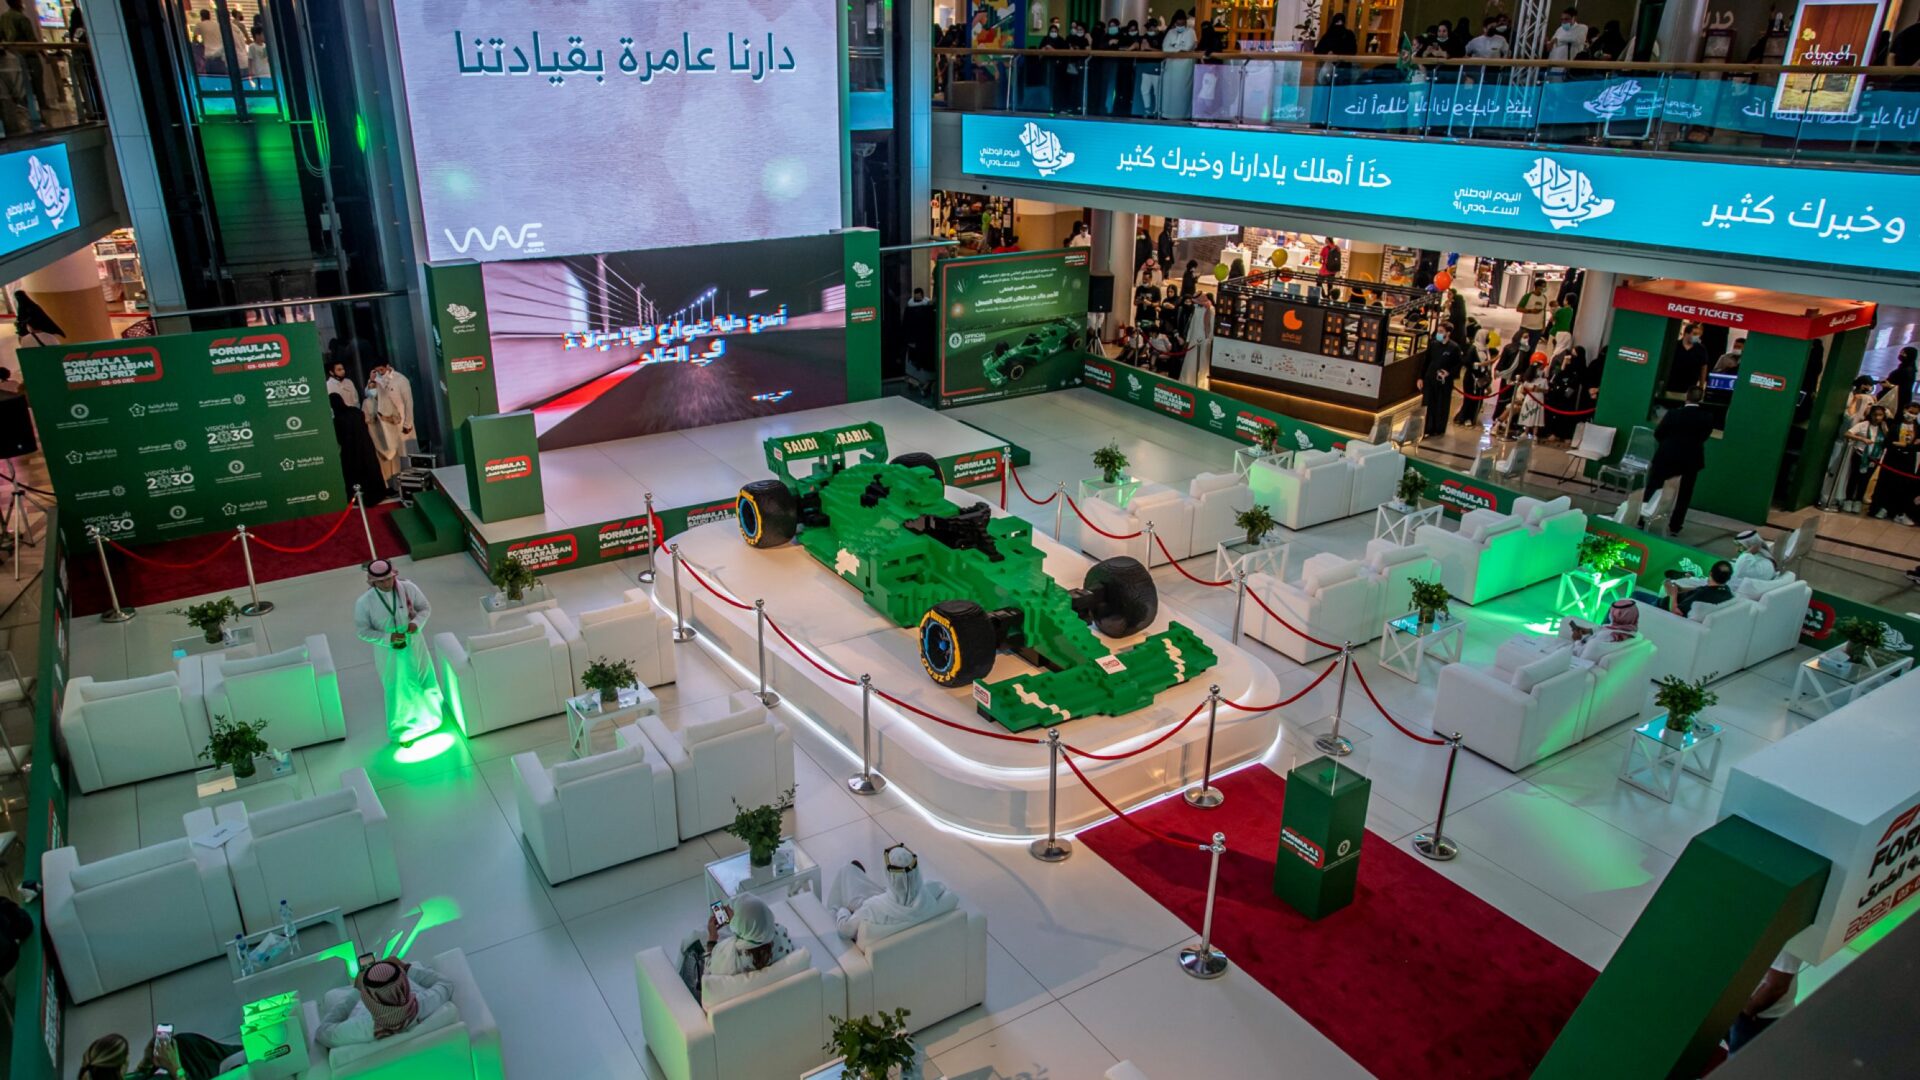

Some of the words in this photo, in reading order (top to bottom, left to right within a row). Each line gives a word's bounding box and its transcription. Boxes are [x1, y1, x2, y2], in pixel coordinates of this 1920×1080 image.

[454, 30, 605, 87] بقيادتنا
[618, 31, 717, 84] عامرة
[728, 31, 797, 83] دارنا
[979, 147, 1003, 157] الوطني
[1004, 149, 1020, 158] اليوم
[1116, 145, 1155, 171] كثير
[986, 157, 1020, 168] السعودي
[1161, 147, 1224, 179] وخيرك
[1230, 151, 1287, 185] يادارنا
[1293, 154, 1355, 185] أهلك
[1454, 187, 1492, 201] الوطني
[1493, 191, 1522, 203] اليوم
[1462, 202, 1520, 215] السعودي
[1701, 192, 1775, 229] كثير
[1787, 198, 1905, 244] وخيرك
[444, 222, 544, 253] WAVE
[1667, 302, 1696, 314] RACE
[1698, 306, 1744, 322] TICKETS
[209, 343, 271, 357] FORMULA
[272, 342, 280, 350] 1
[63, 356, 122, 369] FORMULA
[122, 355, 130, 363] 1
[64, 366, 99, 376] SAUDI
[102, 360, 154, 374] ARABIAN
[66, 372, 108, 383] GRAND
[109, 369, 137, 379] PRIX
[264, 379, 286, 387] VISION
[205, 424, 229, 432] VISION
[783, 437, 819, 454] SAUDI
[485, 462, 521, 472] FORMULA
[954, 458, 991, 471] FORMULA
[144, 469, 169, 477] VISION
[1440, 484, 1483, 505] FORMULA
[1484, 499, 1489, 507] 1
[687, 510, 724, 523] FORMULA
[599, 525, 648, 541] FORMULA
[507, 543, 549, 558] FORMULA
[533, 545, 572, 558] ARABIAN
[539, 554, 559, 563] PRIX
[1282, 829, 1314, 853] FORMULA
[1868, 824, 1920, 879] FOR
